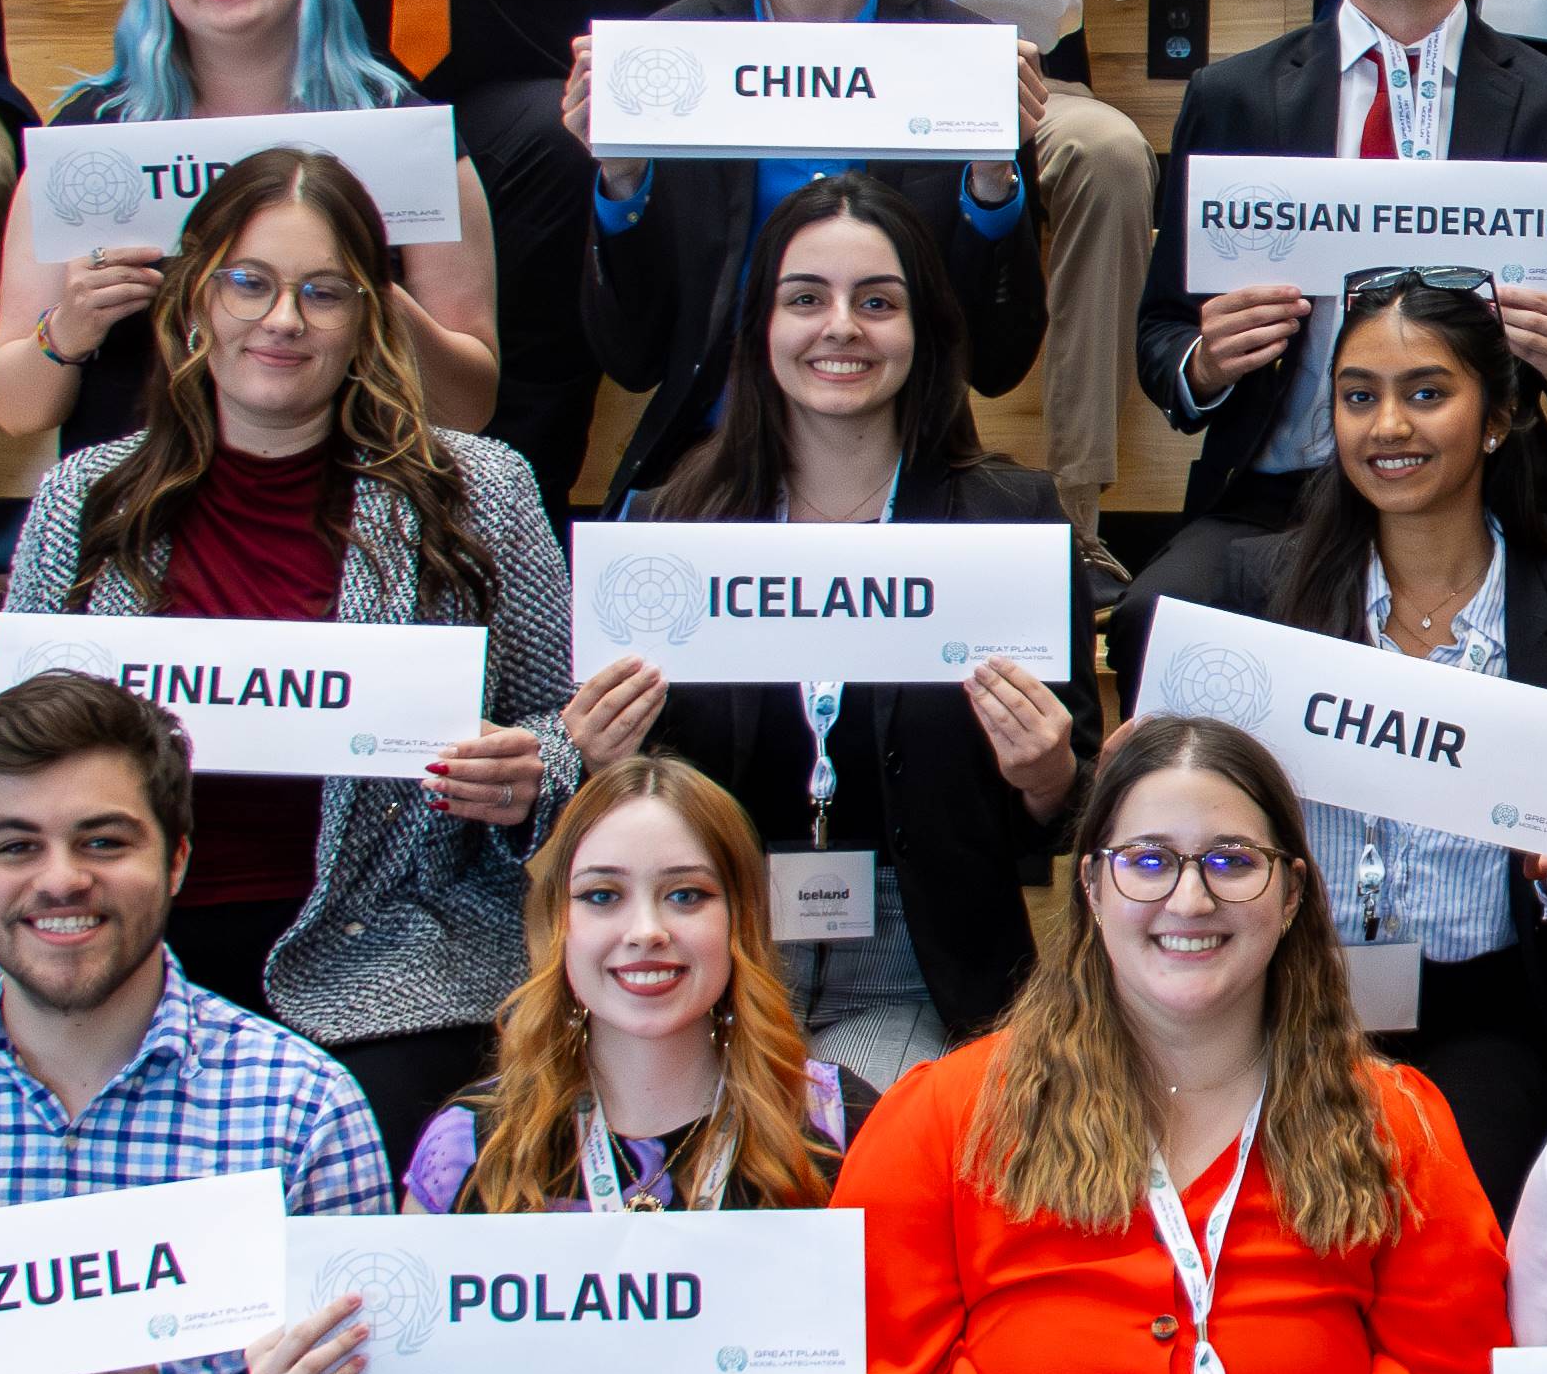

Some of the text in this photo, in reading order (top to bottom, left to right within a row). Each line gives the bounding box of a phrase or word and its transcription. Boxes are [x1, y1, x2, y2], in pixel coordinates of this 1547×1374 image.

[735, 64, 876, 99] CHINA
[1201, 200, 1361, 233] RUSSIAN
[709, 576, 934, 618] ICELAND
[974, 645, 1048, 653] GREAT PLAINS
[119, 663, 351, 709] FINLAND
[1303, 692, 1466, 769] CHAIR
[798, 888, 850, 901] Iceland
[450, 1272, 701, 1323] POLAND
[754, 1349, 840, 1358] GREAT PLAINS
